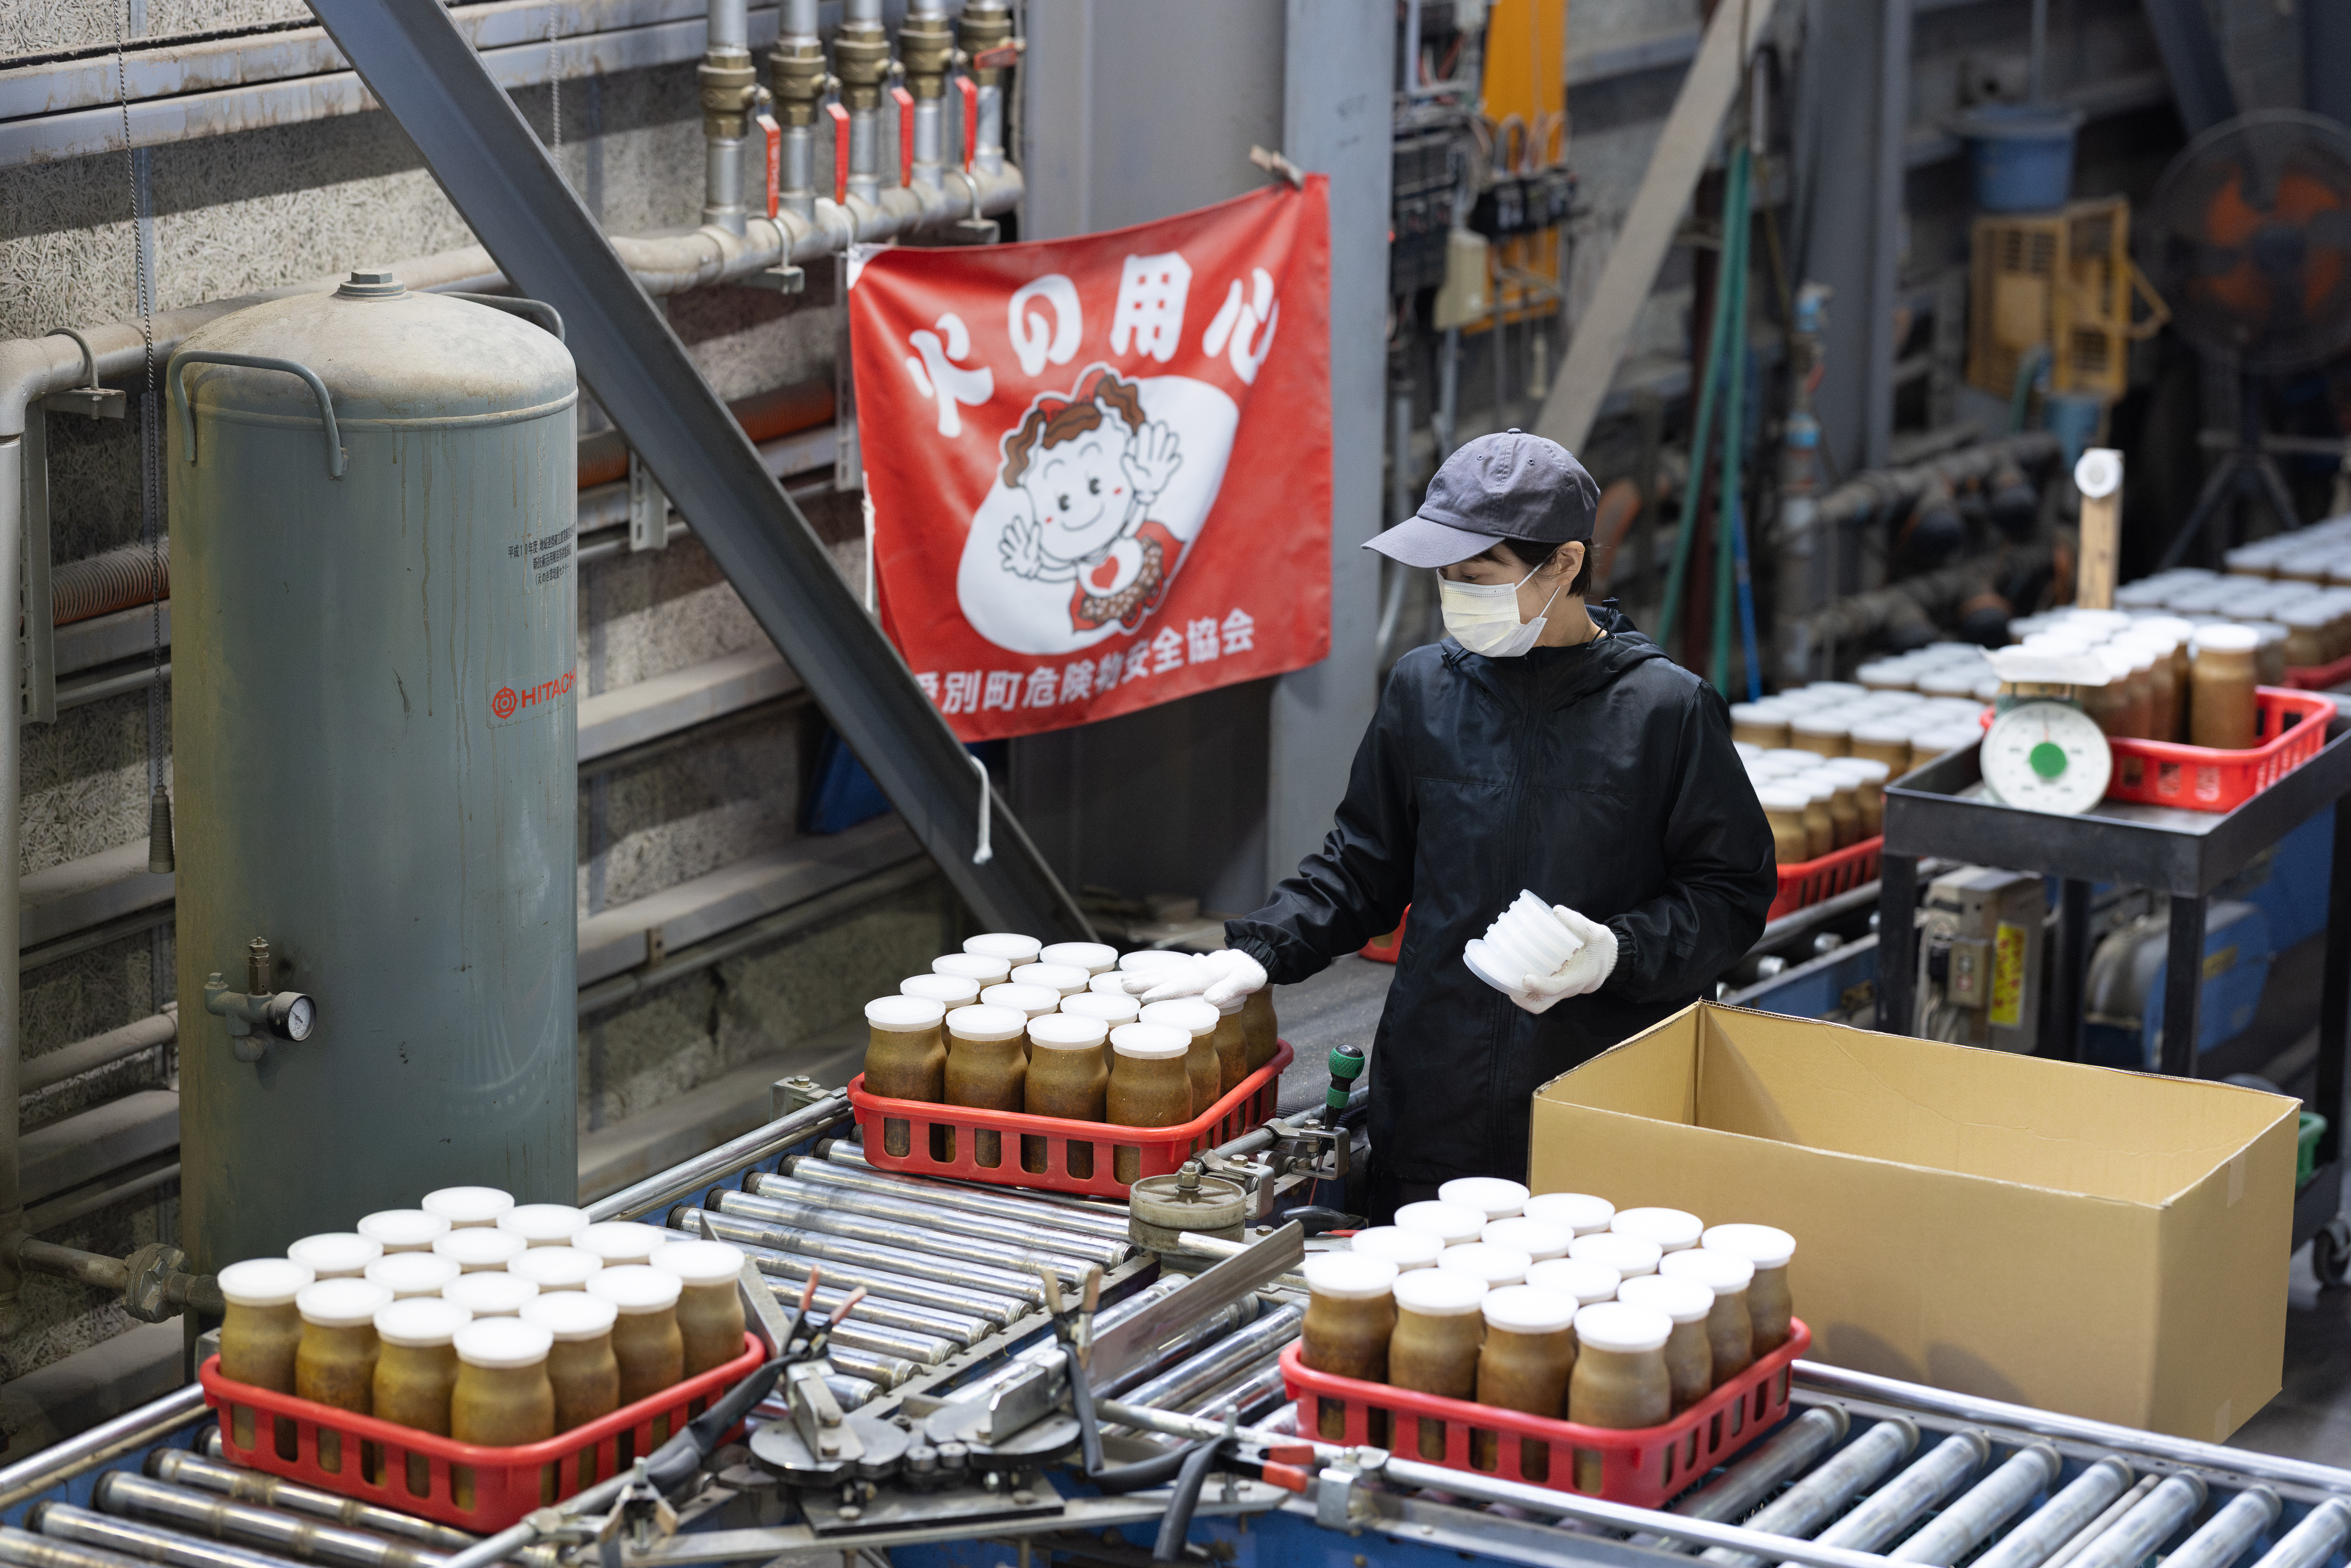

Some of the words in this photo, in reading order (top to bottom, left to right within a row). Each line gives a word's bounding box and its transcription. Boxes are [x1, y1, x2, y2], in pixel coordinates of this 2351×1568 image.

[906, 252, 1280, 438] 火の用心
[522, 665, 576, 708] HITACHI
